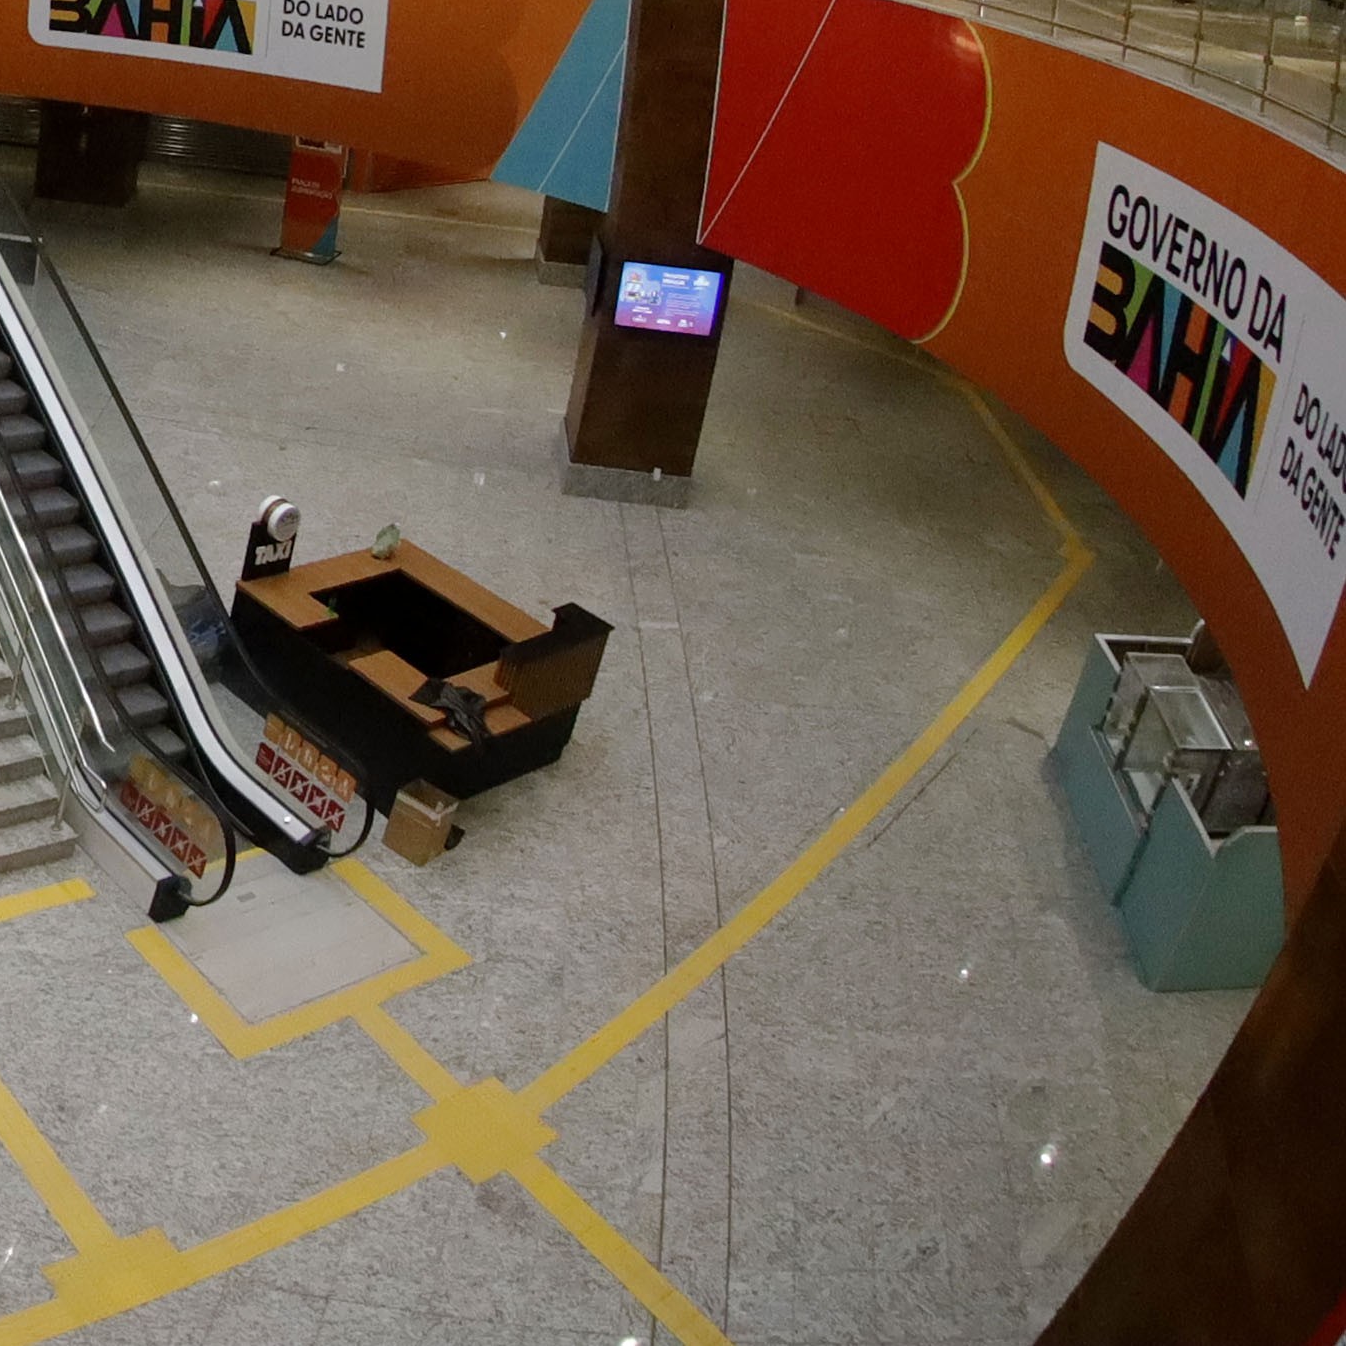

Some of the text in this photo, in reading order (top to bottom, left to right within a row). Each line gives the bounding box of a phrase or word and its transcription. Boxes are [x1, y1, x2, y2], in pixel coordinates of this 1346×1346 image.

[281, 21, 366, 49] DA GENTE
[315, 2, 365, 25] LADO
[1107, 184, 1287, 364] GOVERNO DA
[1083, 241, 1273, 502] BAHIA
[1293, 383, 1322, 442] DO
[1279, 436, 1346, 561] DA GENTE
[255, 540, 293, 566] TAXI
